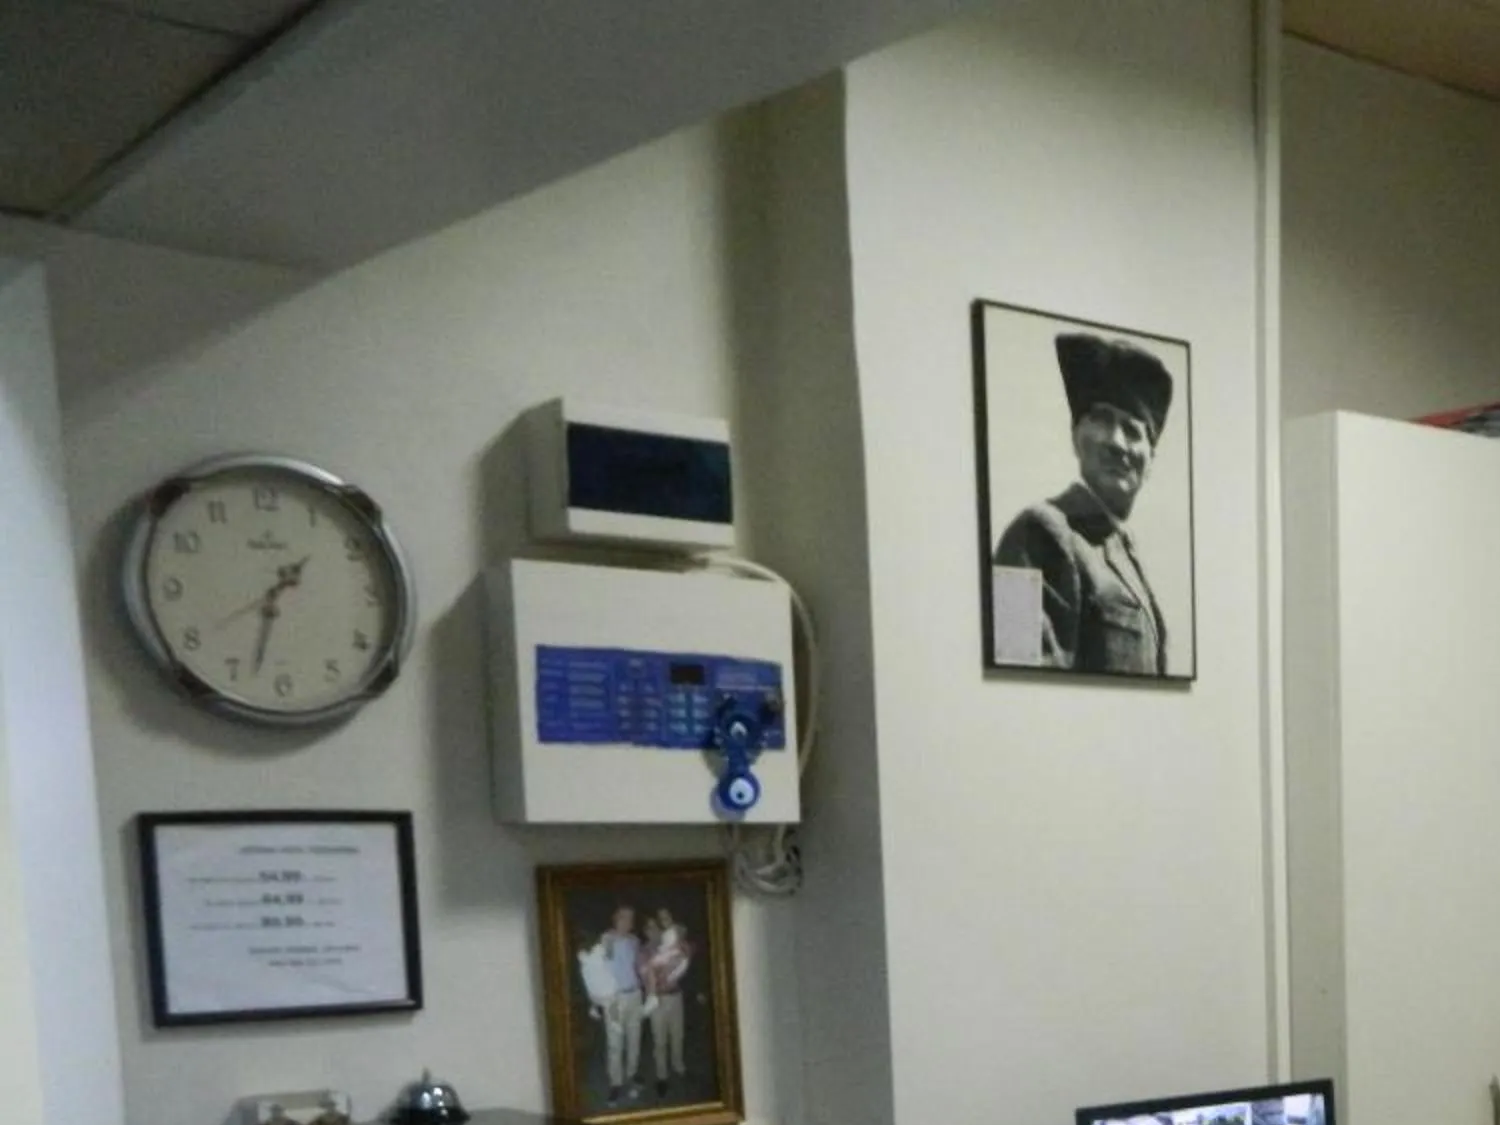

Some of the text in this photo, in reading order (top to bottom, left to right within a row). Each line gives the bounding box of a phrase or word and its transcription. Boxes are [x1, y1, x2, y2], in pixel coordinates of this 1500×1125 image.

[252, 485, 280, 512] 12
[207, 498, 229, 524] 11
[173, 530, 201, 554] 10
[162, 577, 183, 600] 9
[183, 627, 201, 651] 8
[224, 657, 241, 682] 7
[273, 674, 294, 698] 6
